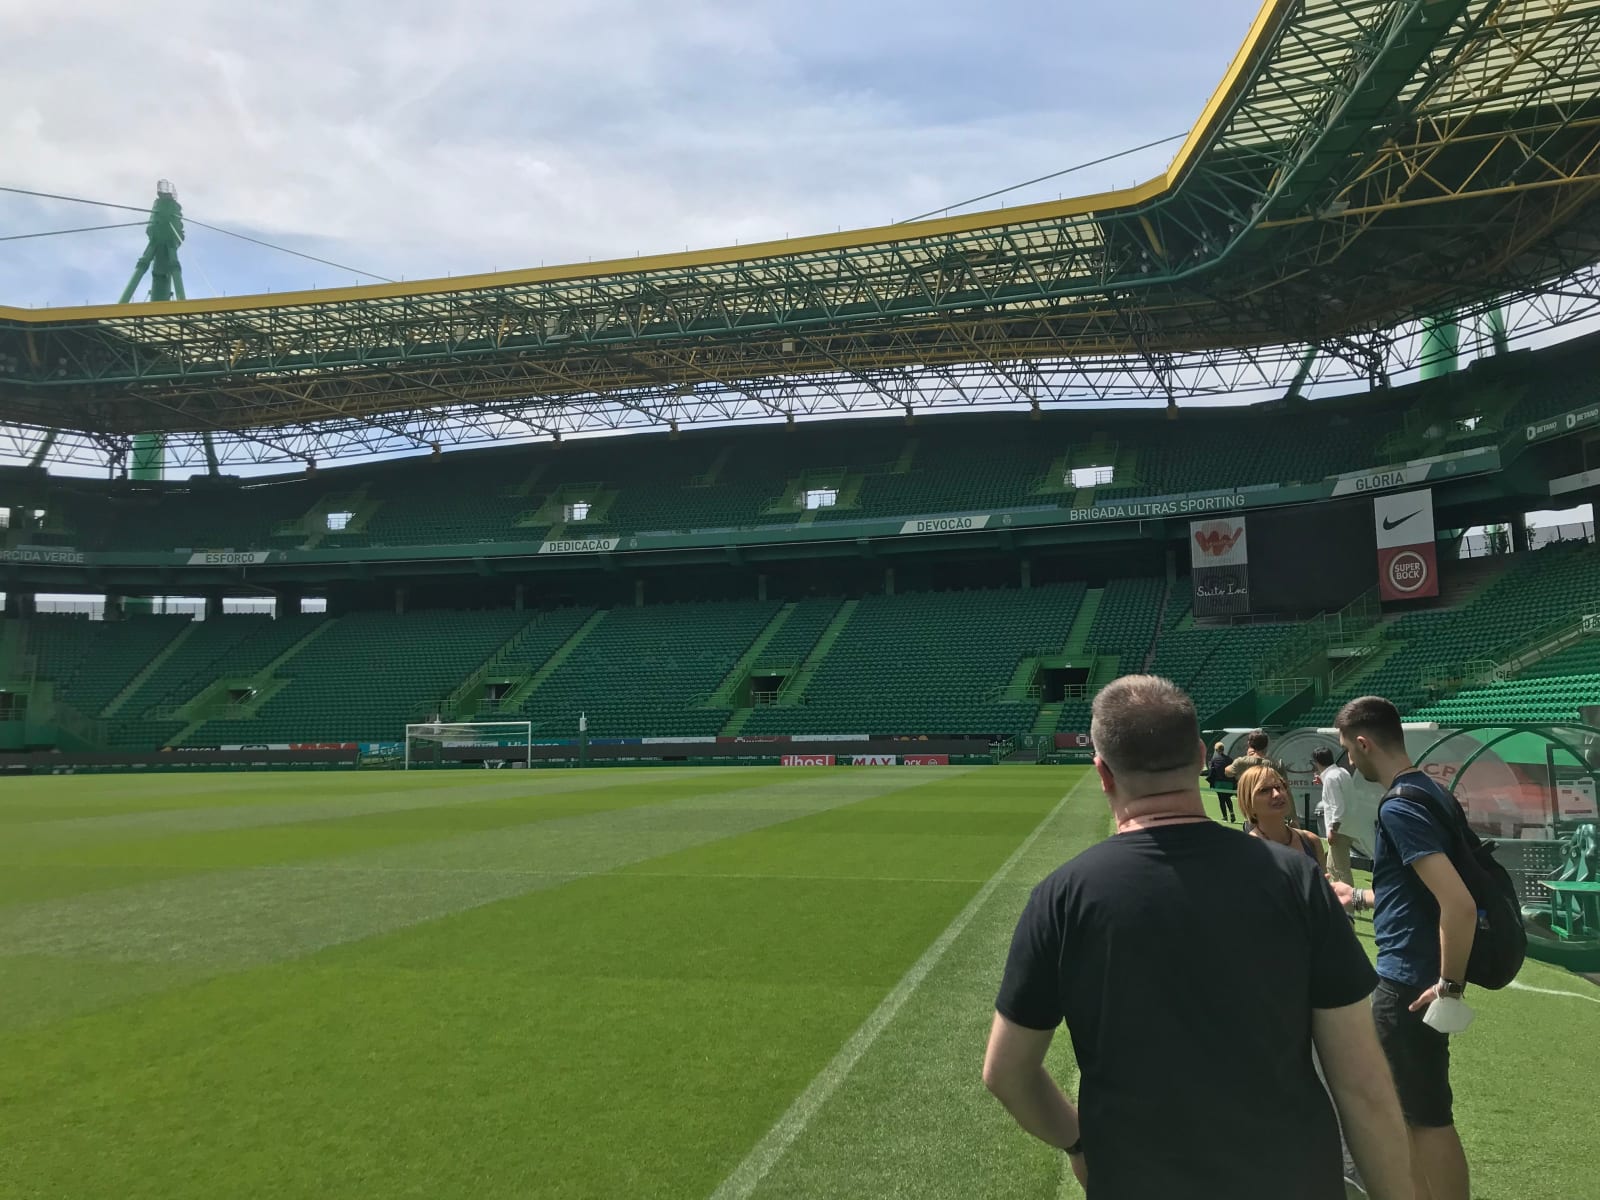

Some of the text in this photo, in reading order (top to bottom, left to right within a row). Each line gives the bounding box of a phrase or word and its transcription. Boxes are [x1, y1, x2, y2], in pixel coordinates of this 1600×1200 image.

[1070, 494, 1245, 521] BRIGADA ULTRAS SPORTING
[43, 552, 84, 563] VERDE
[1394, 562, 1421, 572] SUPER
[1396, 570, 1420, 580] BOCK
